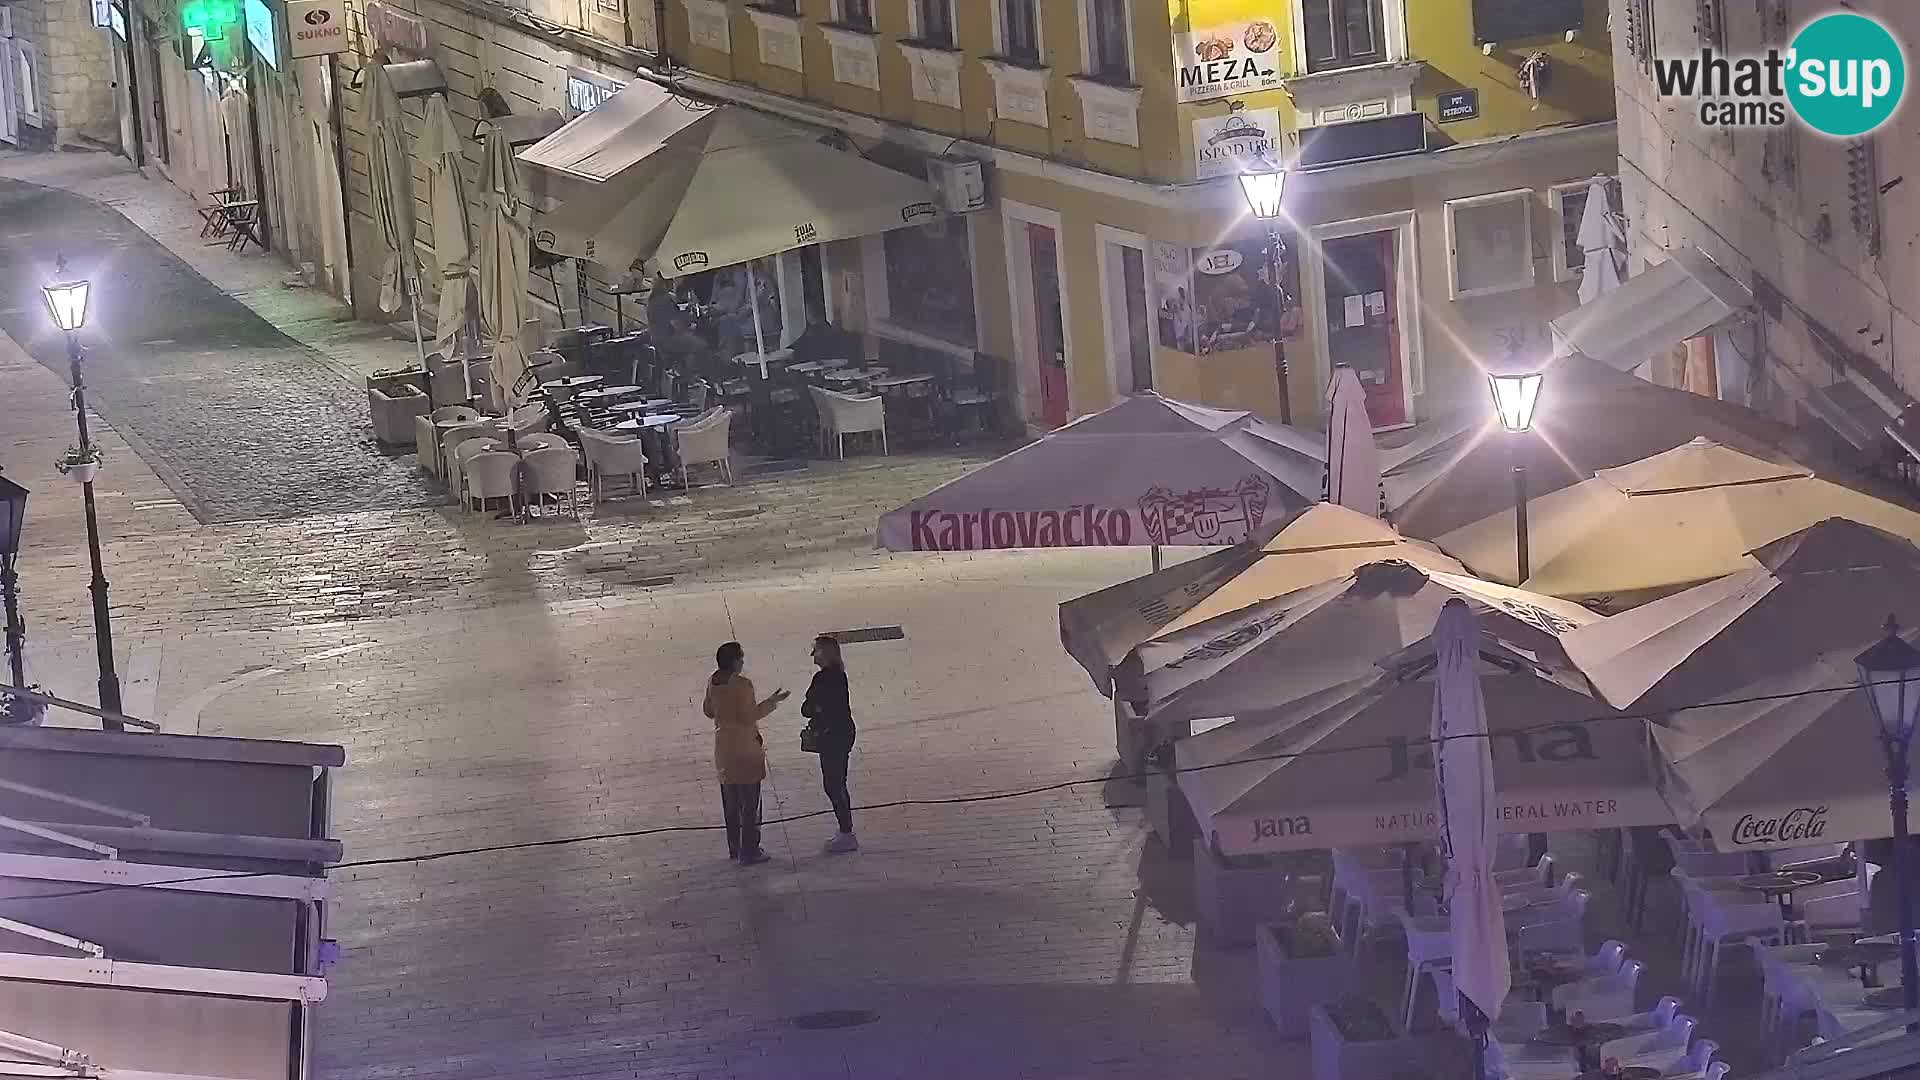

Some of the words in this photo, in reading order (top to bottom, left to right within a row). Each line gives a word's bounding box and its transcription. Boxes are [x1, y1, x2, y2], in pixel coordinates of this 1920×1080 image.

[296, 27, 342, 41] SUKNO
[1180, 57, 1259, 88] MEZA
[1190, 84, 1222, 97] PIZZERIA
[1230, 79, 1251, 91] GRILL
[1261, 78, 1277, 86] 80m
[1200, 143, 1245, 161] ISPOD
[910, 503, 1132, 551] Karlovačko
[1375, 811, 1437, 831] NATUR
[1553, 799, 1618, 818] WATER
